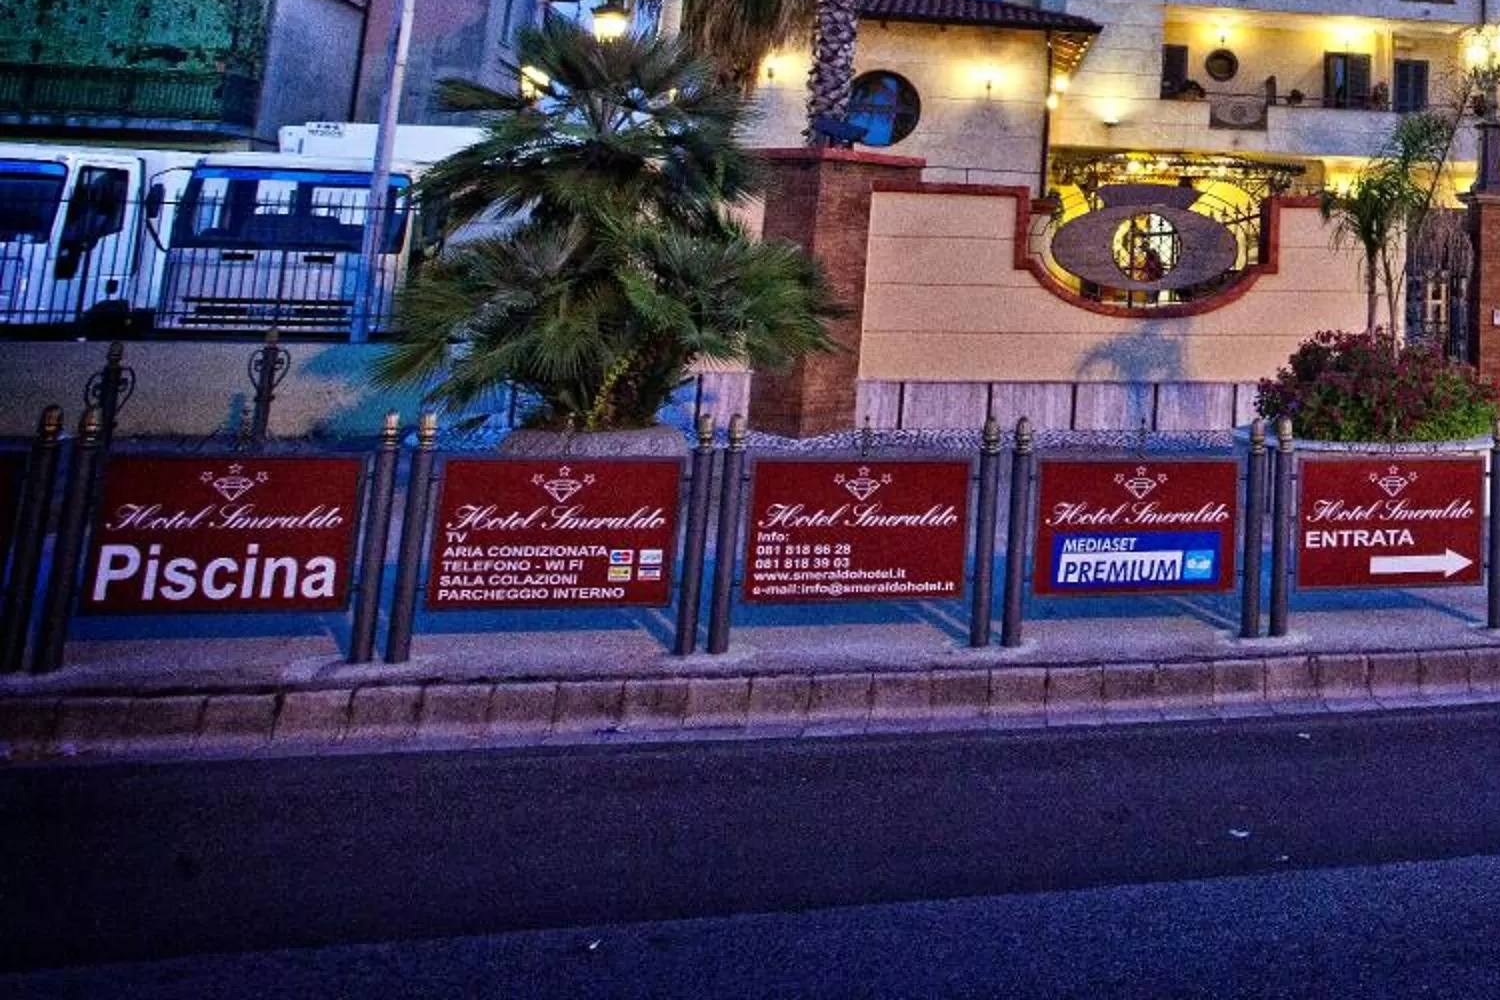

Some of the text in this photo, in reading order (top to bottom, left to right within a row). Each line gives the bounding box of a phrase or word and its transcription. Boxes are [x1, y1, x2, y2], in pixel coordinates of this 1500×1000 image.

[105, 502, 345, 532] Hotel Smeraldo
[446, 503, 666, 532] Hotel Smeraldo
[757, 502, 959, 529] Hotel Smeraldo
[1045, 500, 1230, 526] Hotel Smeraldo
[1306, 498, 1476, 523] Hotel Smeraldo
[446, 531, 468, 543] TV
[757, 531, 790, 542] Info:
[1305, 529, 1415, 548] ENTRATA
[443, 545, 608, 558] ARIA CONDIZIONATA
[756, 545, 781, 555] 081
[834, 543, 851, 554] 28
[1063, 537, 1137, 552] MEDIASET
[443, 560, 530, 572] TELEFONO
[545, 560, 566, 571] WI
[570, 559, 584, 571] FI
[755, 558, 779, 569] 081
[784, 558, 809, 569] 818
[1064, 559, 1178, 582] PREMIUM
[92, 543, 337, 601] Piscina
[753, 568, 906, 582] www.smeraldohotel.it
[440, 573, 578, 586] SALA COLAZIONI
[438, 587, 625, 601] PARCHEGGIO INTERNO
